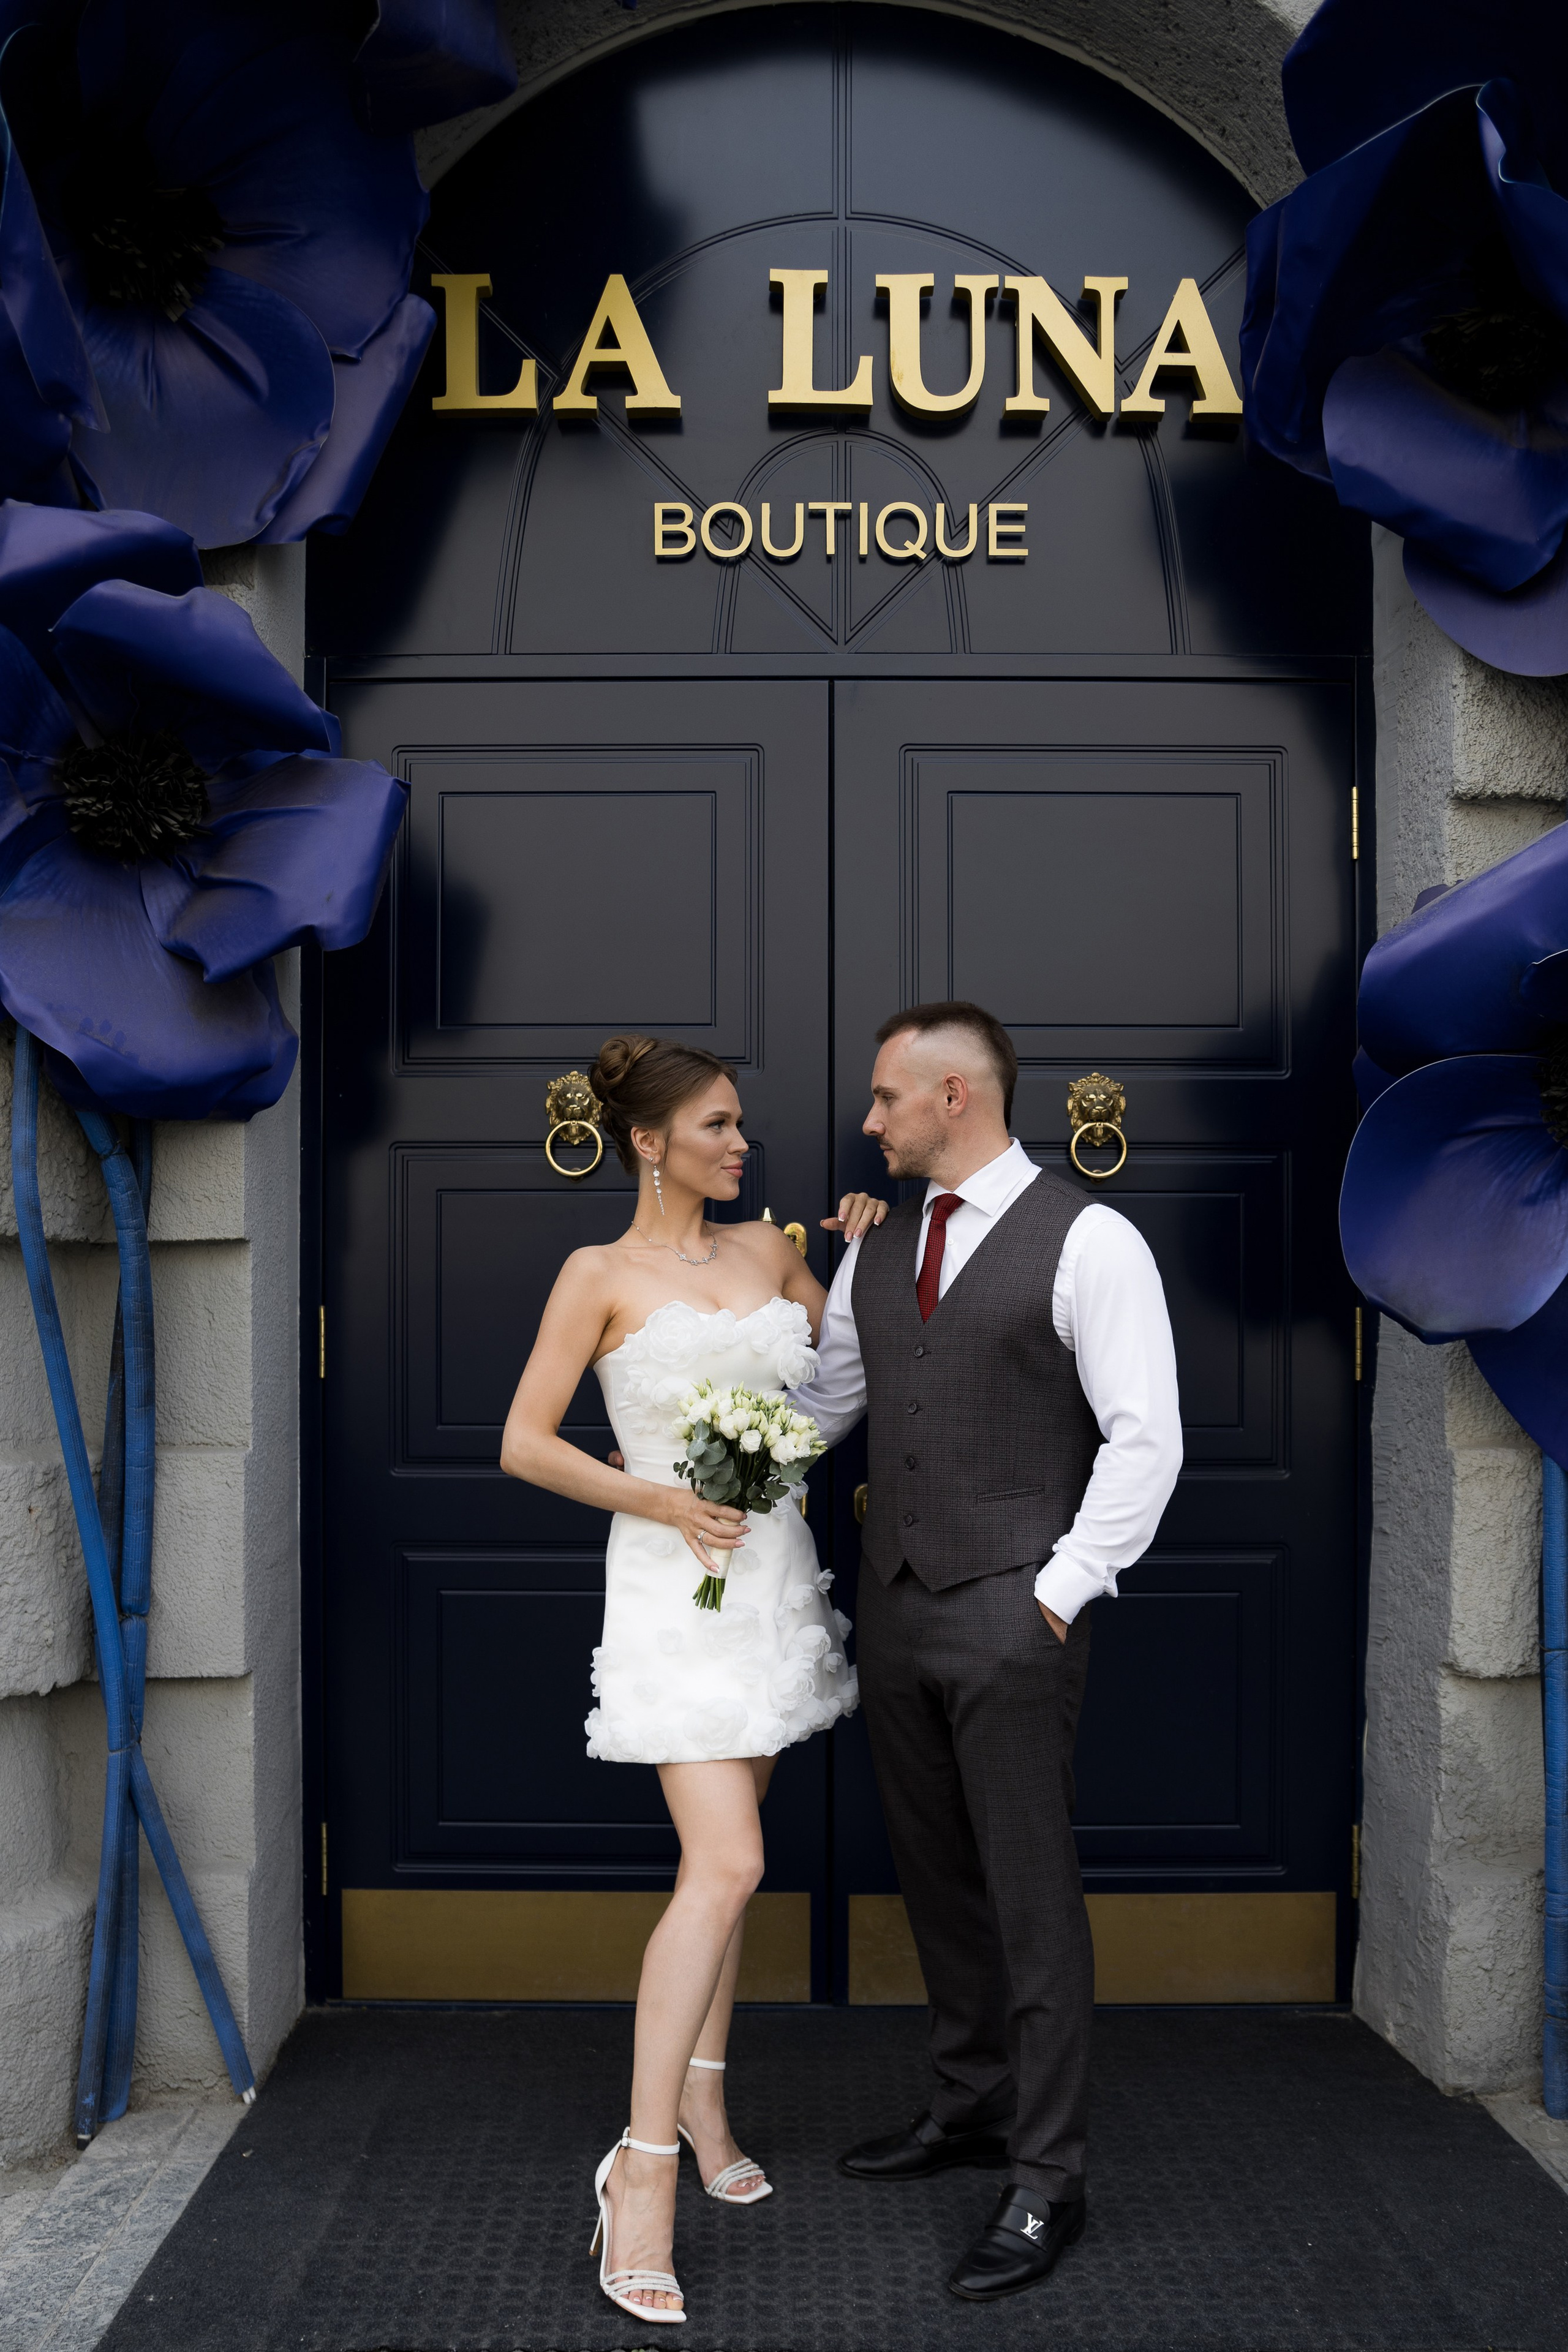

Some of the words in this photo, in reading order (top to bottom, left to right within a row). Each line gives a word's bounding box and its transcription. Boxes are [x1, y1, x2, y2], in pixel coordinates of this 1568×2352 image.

[431, 273, 681, 419] LA
[767, 268, 1243, 423] LUNA
[654, 501, 1029, 560] BOUTIQUE
[1020, 2212, 1044, 2239] LV
